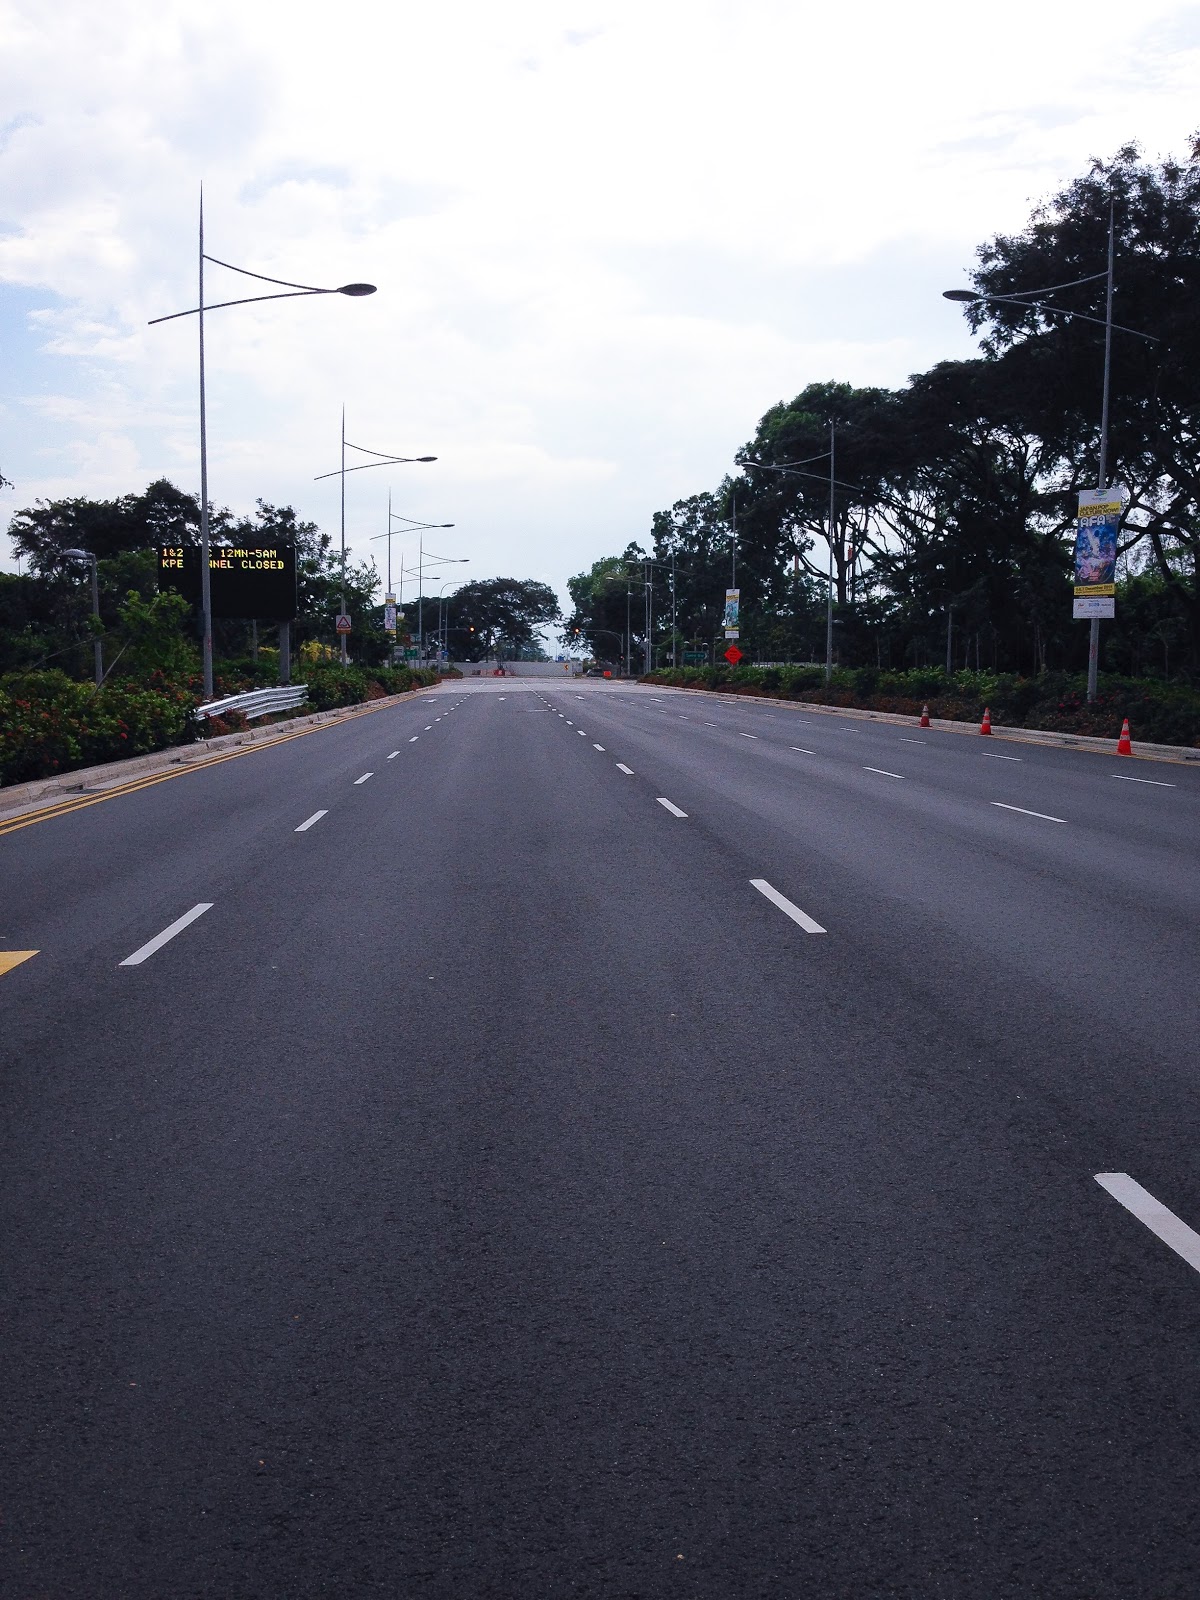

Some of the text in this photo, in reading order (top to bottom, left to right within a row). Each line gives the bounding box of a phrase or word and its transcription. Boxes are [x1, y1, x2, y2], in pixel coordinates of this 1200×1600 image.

[1080, 515, 1106, 528] AFA
[162, 548, 184, 557] 1&2
[220, 548, 277, 558] 12MN-5AM
[162, 559, 285, 570] KPE NNEL CLOSED
